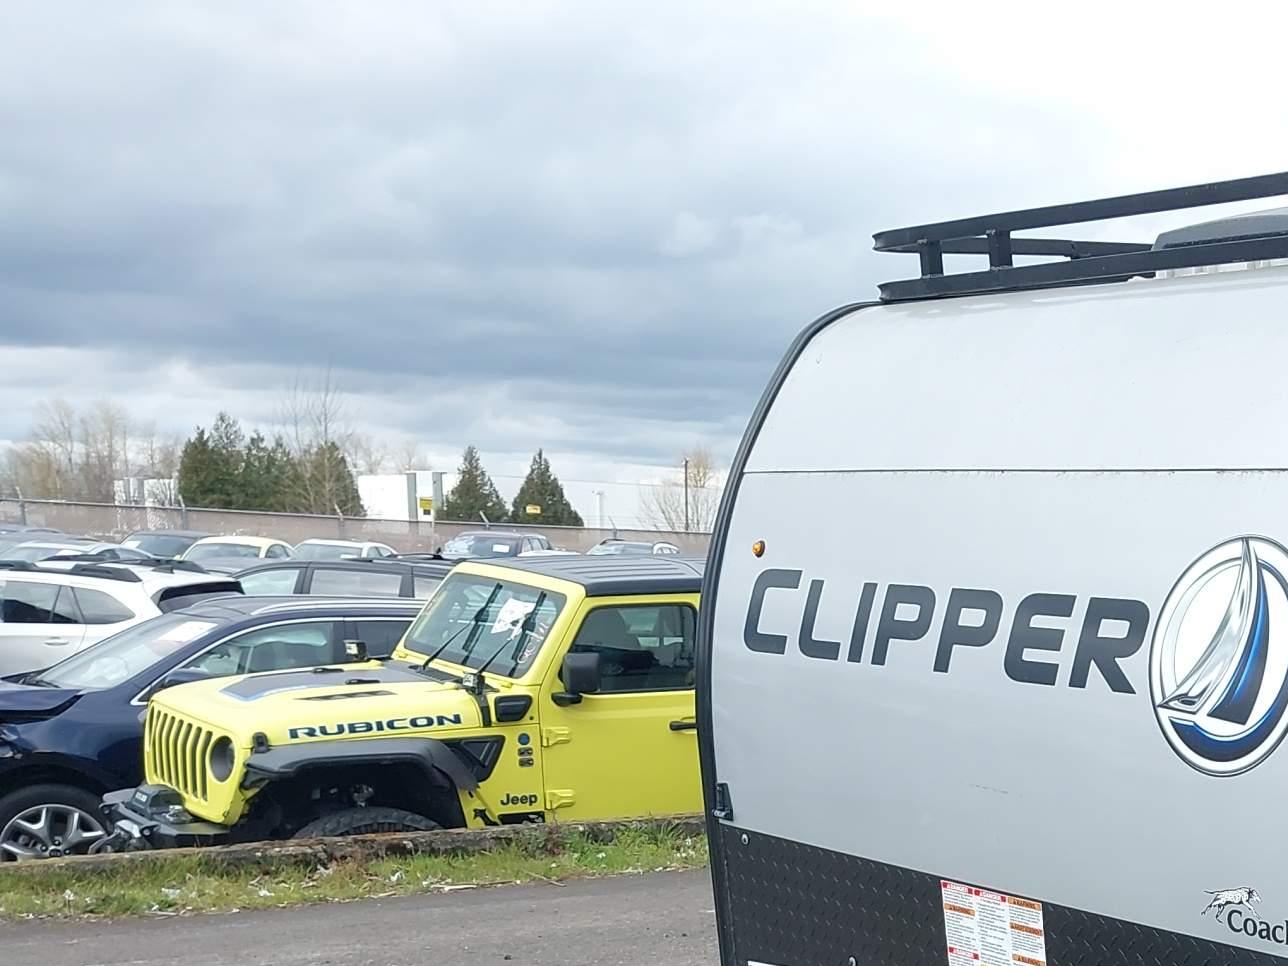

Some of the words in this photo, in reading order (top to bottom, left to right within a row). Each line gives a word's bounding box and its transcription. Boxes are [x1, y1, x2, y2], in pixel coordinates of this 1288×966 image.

[743, 568, 1151, 695] CLIPPER
[288, 713, 463, 739] RUBICON
[500, 793, 538, 807] Jeep
